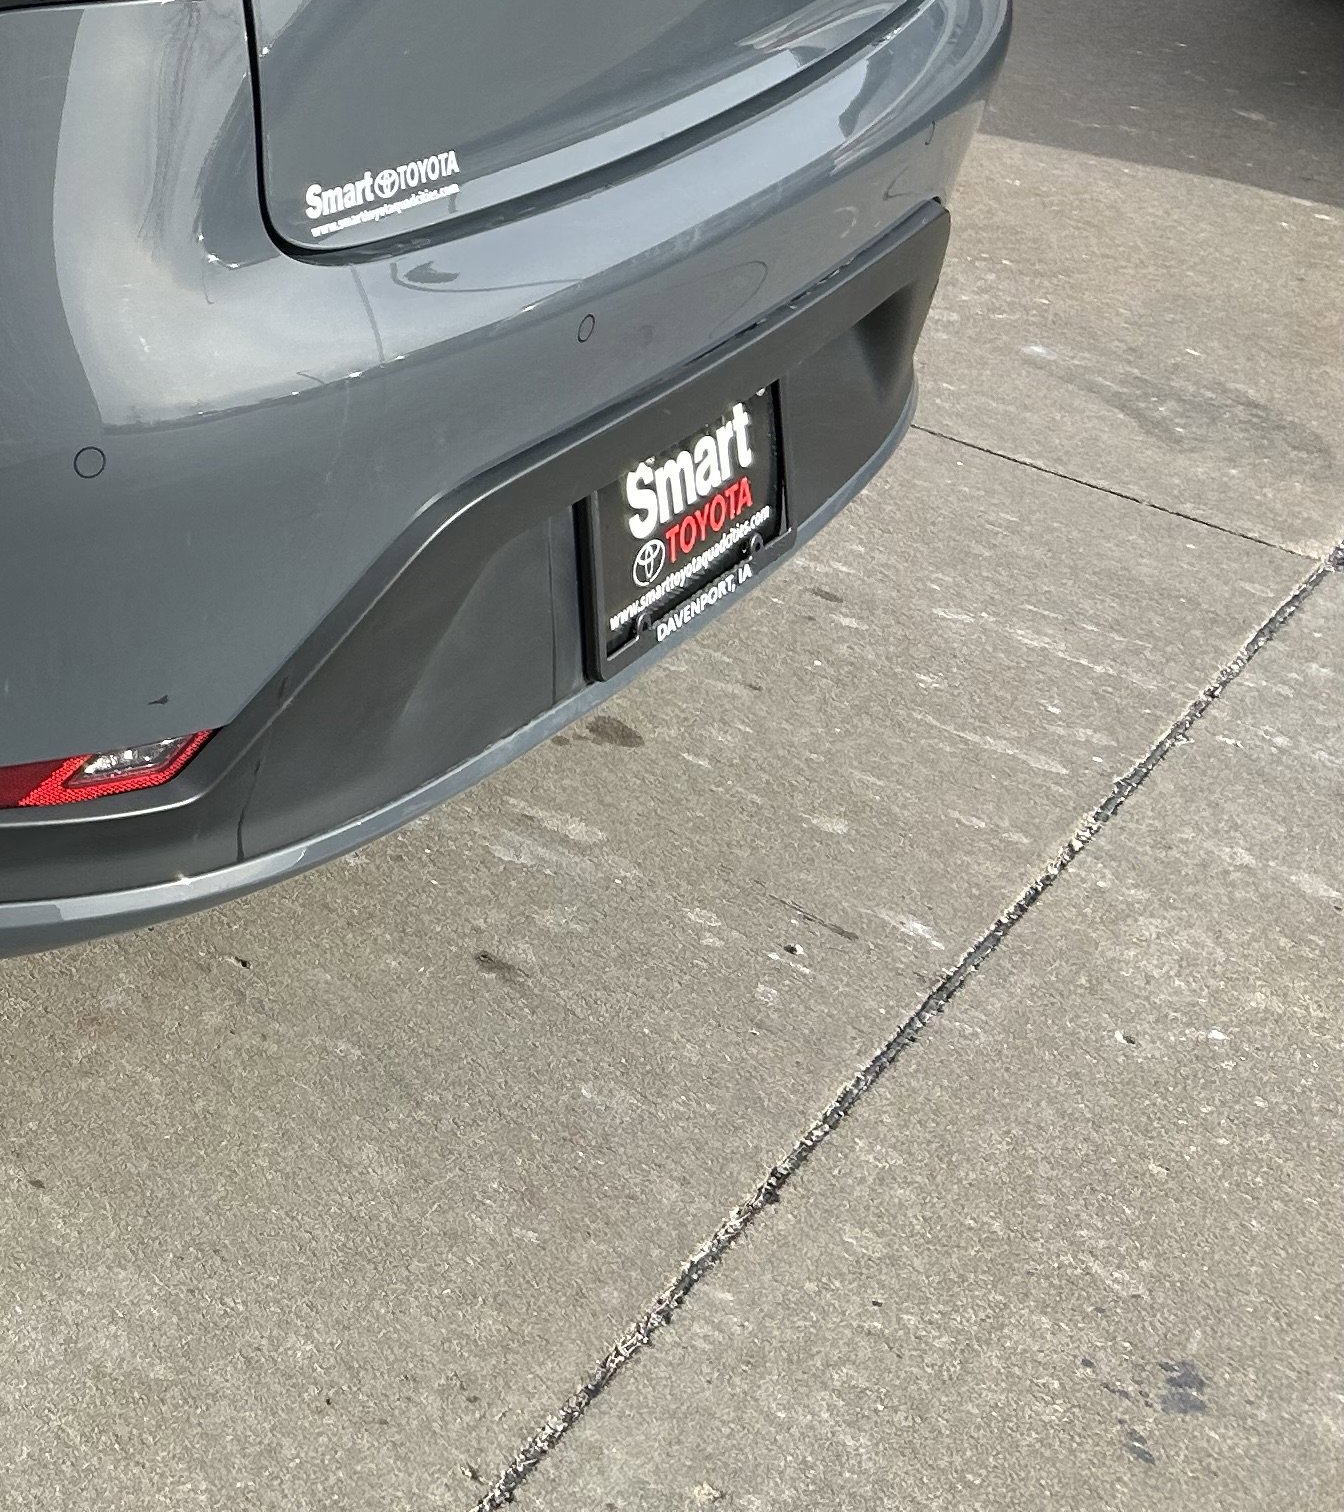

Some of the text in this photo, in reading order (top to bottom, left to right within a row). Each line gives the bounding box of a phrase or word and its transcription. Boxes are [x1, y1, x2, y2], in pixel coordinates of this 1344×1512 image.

[305, 150, 461, 220] Smart TOYOTA
[625, 401, 754, 540] Smart
[665, 475, 754, 564] TOYOTA
[609, 504, 771, 631] www.smarttoyotaquadcities.com
[656, 563, 753, 642] DAVENPORT, IA
